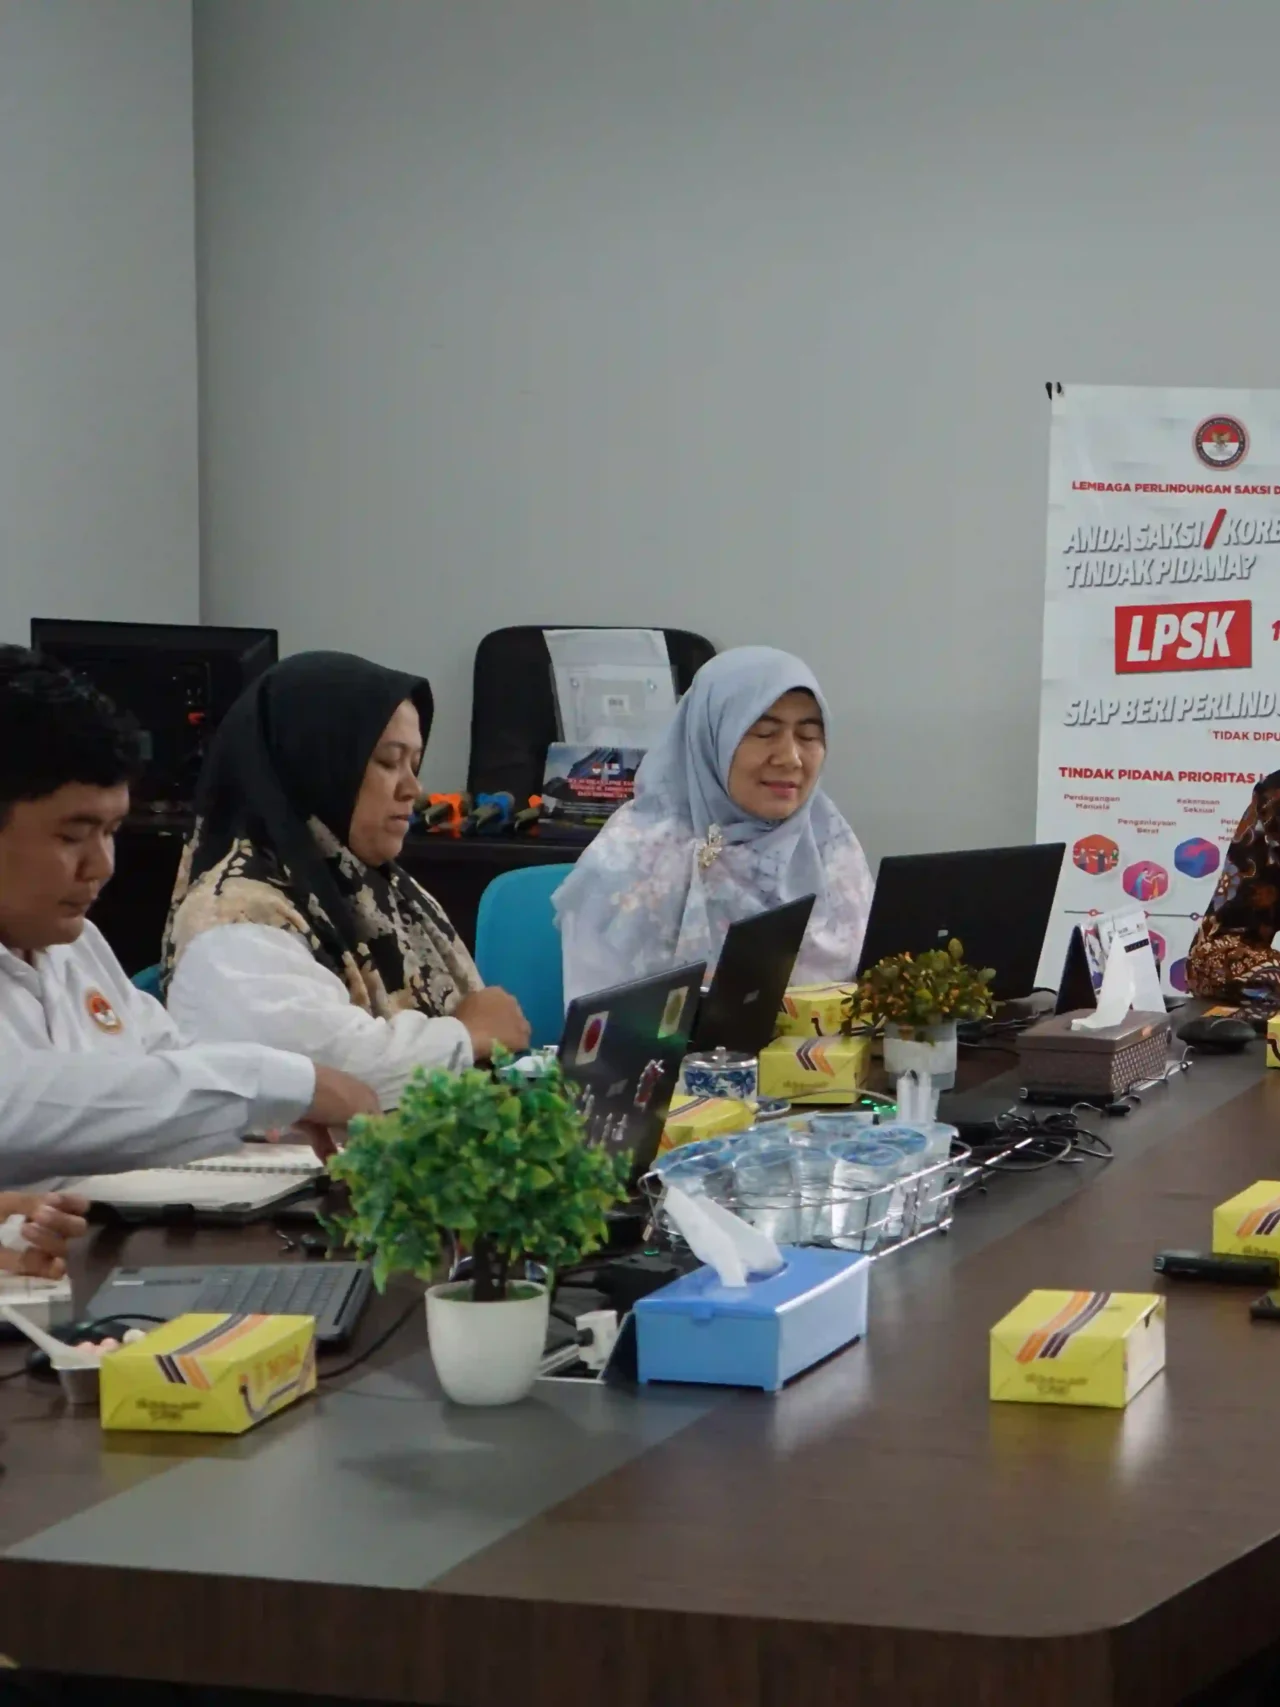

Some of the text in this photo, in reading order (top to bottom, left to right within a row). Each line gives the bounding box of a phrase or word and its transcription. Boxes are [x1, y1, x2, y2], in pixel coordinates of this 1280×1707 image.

[1072, 481, 1131, 493] LEMBAGA
[1135, 482, 1231, 495] PERLINDUNGAN
[1234, 484, 1271, 495] SAKSI
[1063, 525, 1133, 554] ANDA
[1065, 553, 1257, 588] TINDAK PIDANA?
[1127, 610, 1235, 662] LPSK
[1063, 698, 1120, 726] SIAP
[1121, 696, 1176, 724] BERI
[1213, 730, 1249, 741] TIDAK
[1059, 767, 1114, 780] TINDAK
[1118, 769, 1174, 781] PIDANA
[1179, 771, 1255, 784] PRIORITAS
